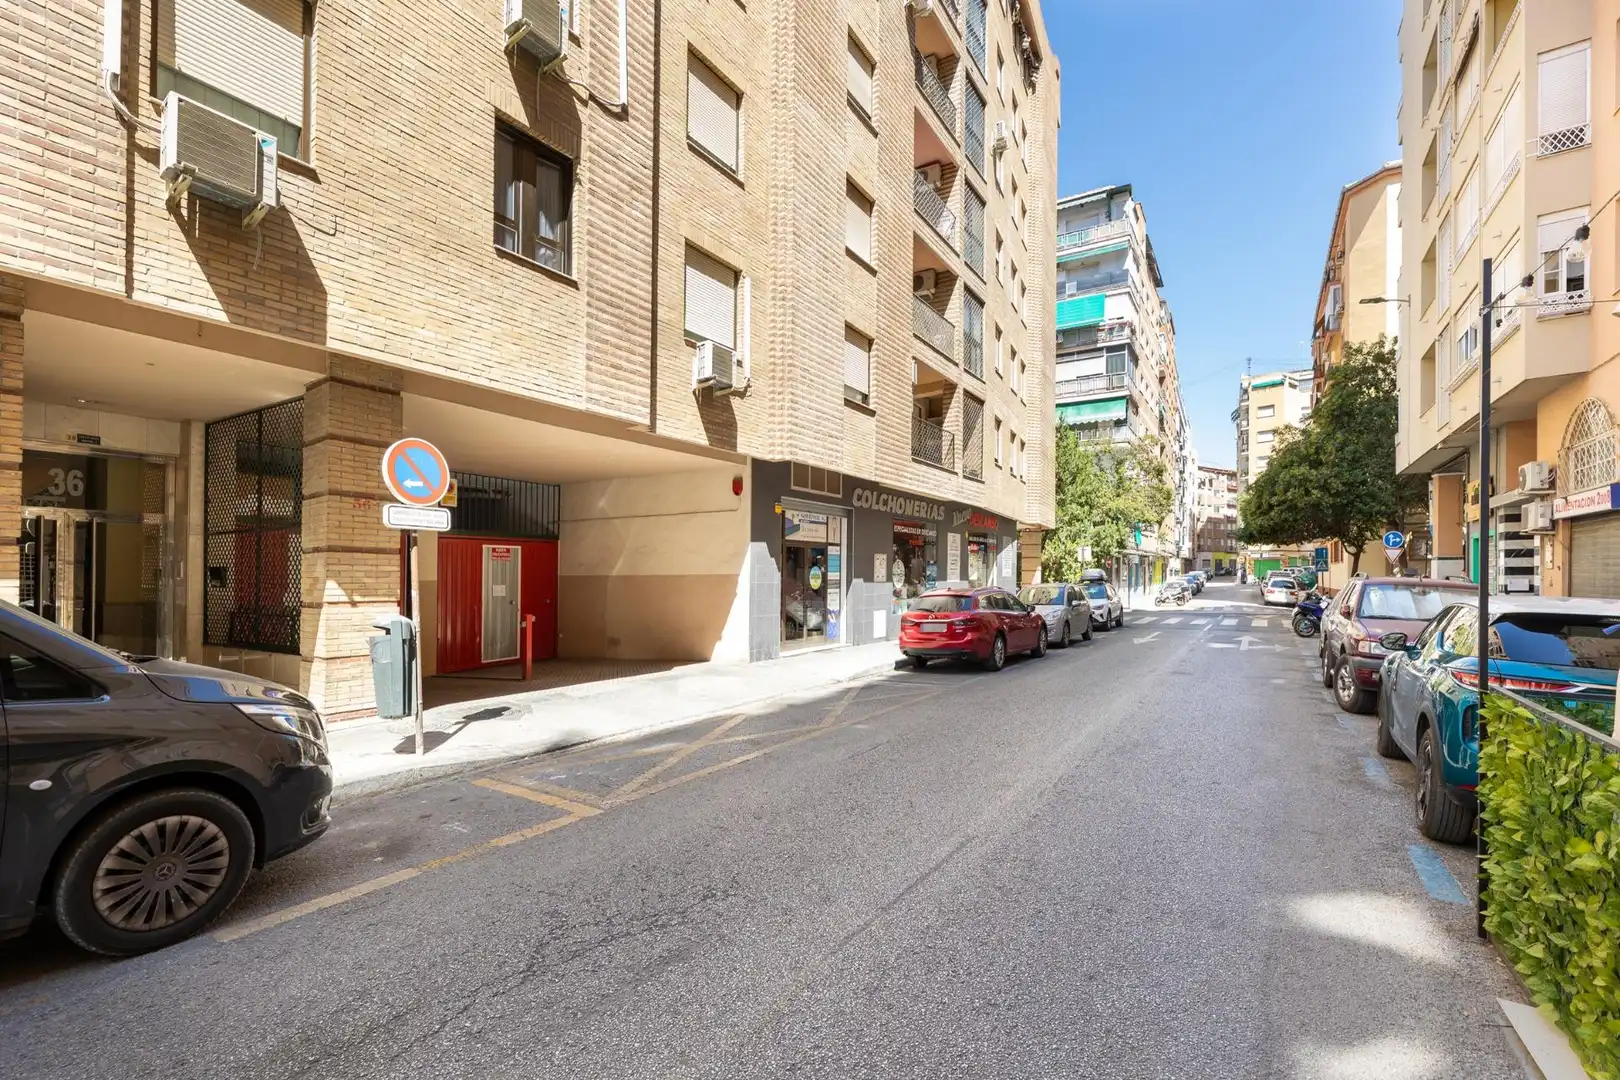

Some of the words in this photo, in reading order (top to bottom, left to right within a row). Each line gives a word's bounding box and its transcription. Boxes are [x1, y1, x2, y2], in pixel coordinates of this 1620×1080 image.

[47, 468, 84, 496] 36
[852, 488, 945, 520] COLCHONERÍAS
[1555, 495, 1596, 512] ALMENTACION
